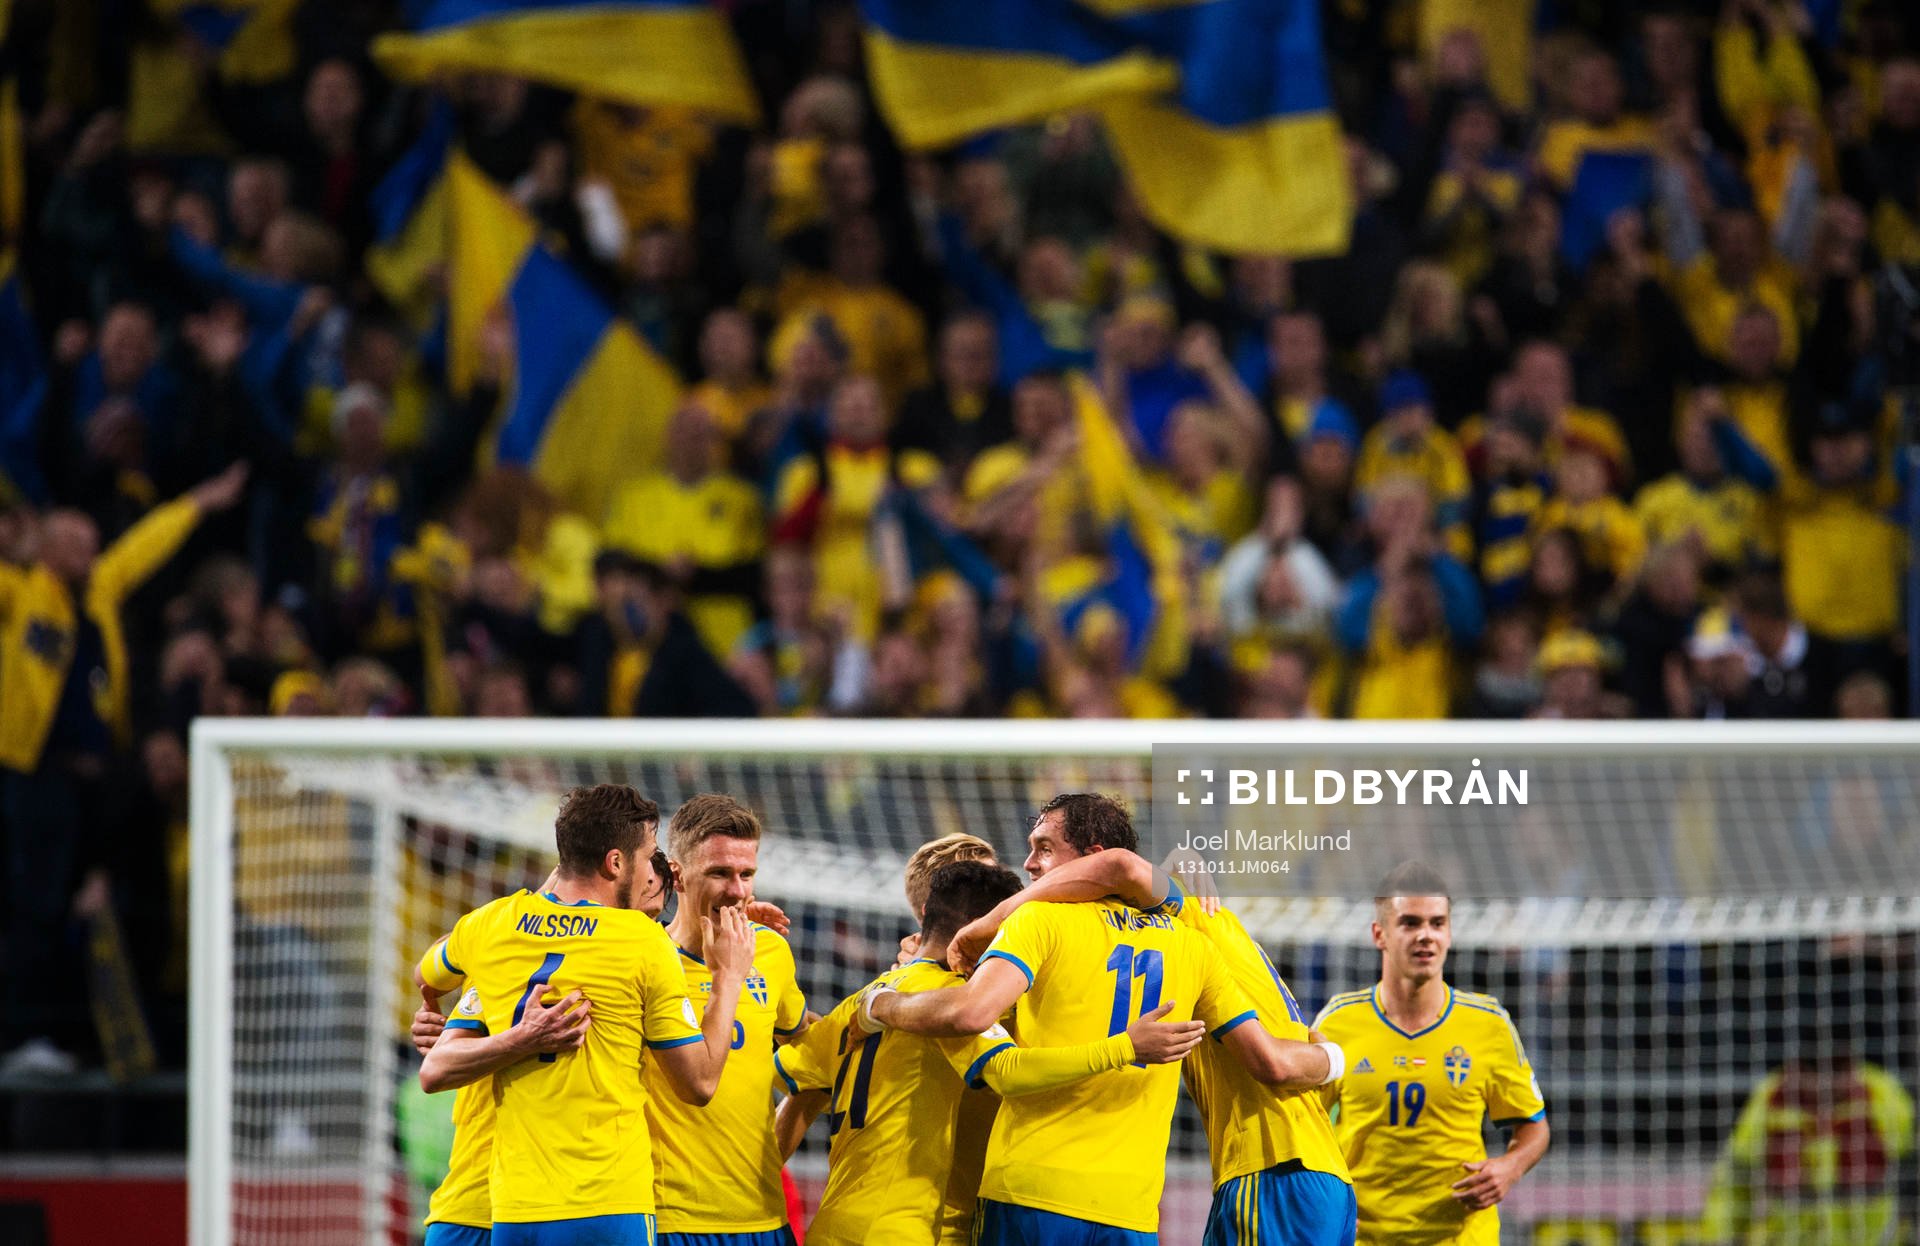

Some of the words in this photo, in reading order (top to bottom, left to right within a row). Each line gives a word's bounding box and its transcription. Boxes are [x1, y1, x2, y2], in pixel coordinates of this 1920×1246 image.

[516, 913, 598, 937] NILSSON
[1107, 943, 1163, 1069] 11
[1385, 1081, 1426, 1127] 19
